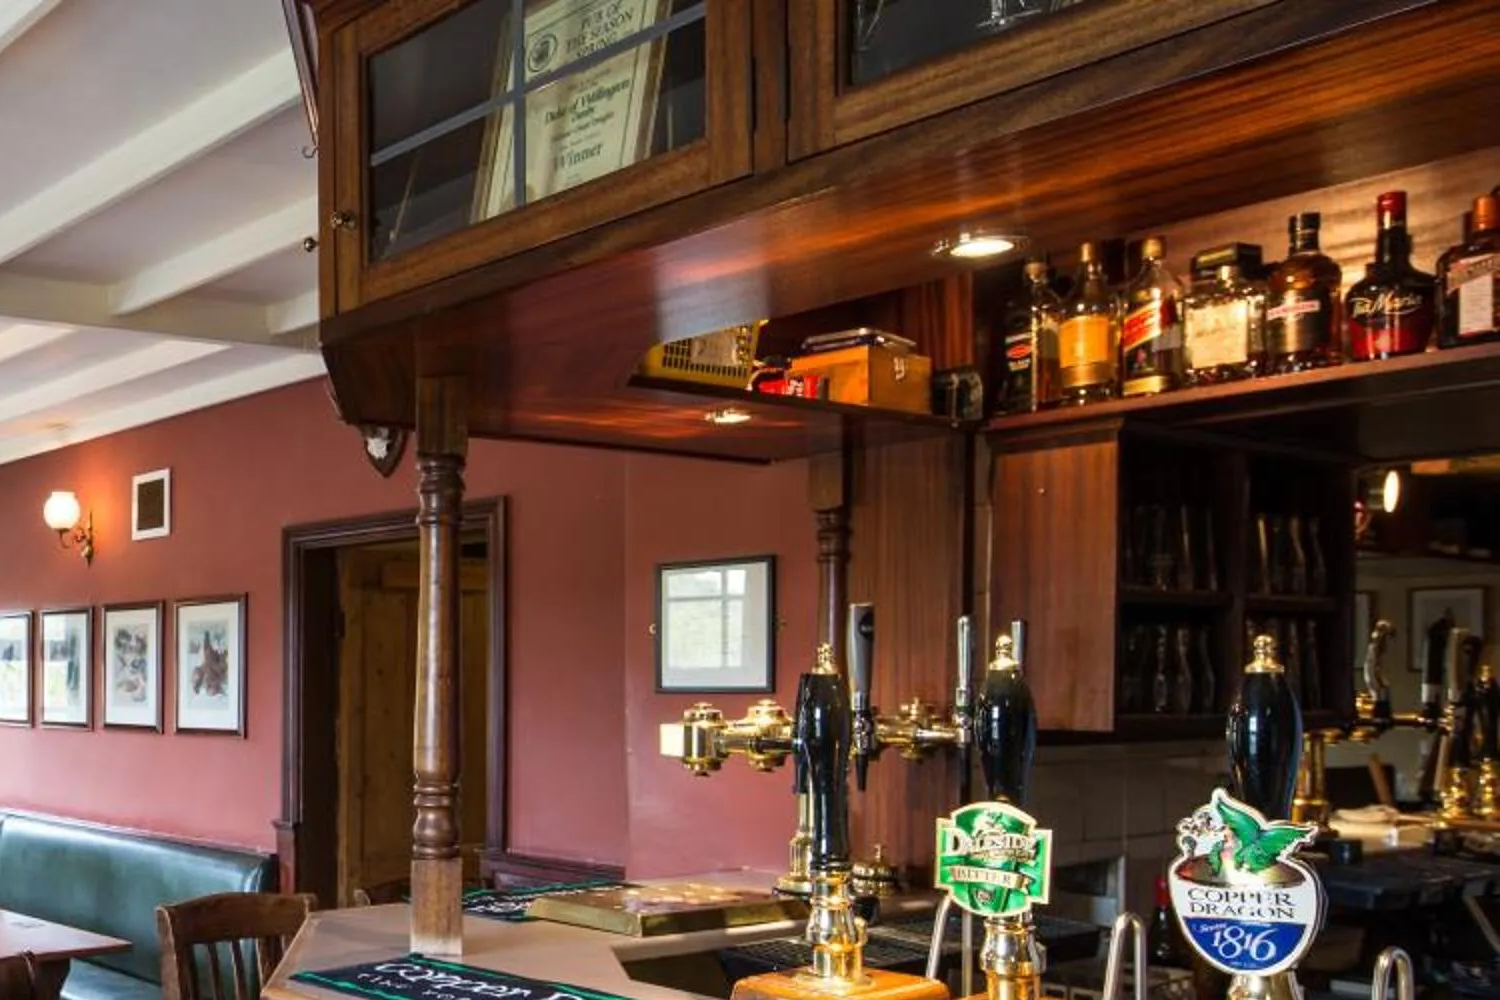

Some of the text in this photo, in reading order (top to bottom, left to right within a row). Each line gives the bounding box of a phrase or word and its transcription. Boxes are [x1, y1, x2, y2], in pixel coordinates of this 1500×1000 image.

[1187, 887, 1296, 906] COPPER
[1190, 902, 1295, 919] DRAGON
[1211, 925, 1279, 961] 1816
[374, 963, 532, 998] Copper
